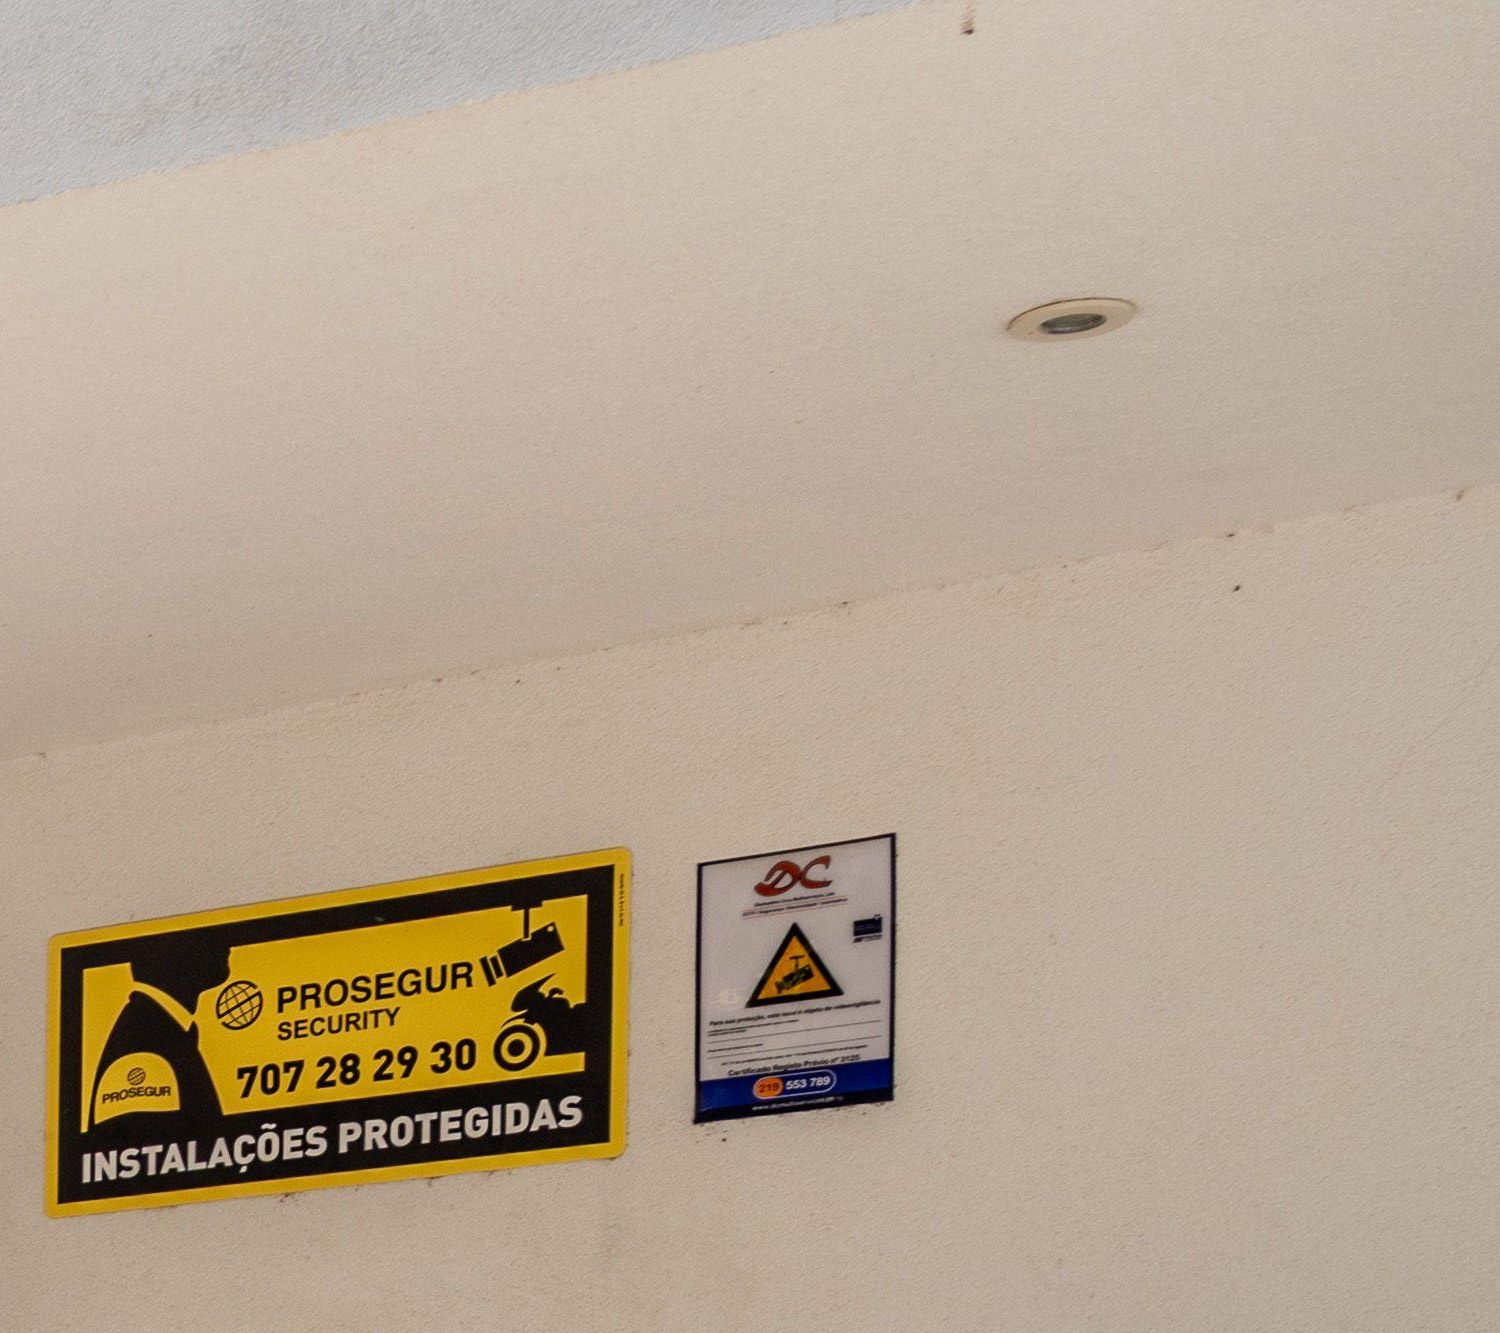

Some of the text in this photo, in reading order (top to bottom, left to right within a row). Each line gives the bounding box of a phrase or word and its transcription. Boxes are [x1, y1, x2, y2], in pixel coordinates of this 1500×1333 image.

[276, 961, 474, 1014] PROSEGUR
[277, 1006, 401, 1042] SECURITY
[236, 1038, 477, 1098] 707 28 29 30
[786, 1079, 808, 1091] 553
[809, 1076, 831, 1087] 789
[102, 1085, 171, 1104] PROSEGUR
[81, 1095, 583, 1183] INSTALAÇÕES PROTEGIDAS
